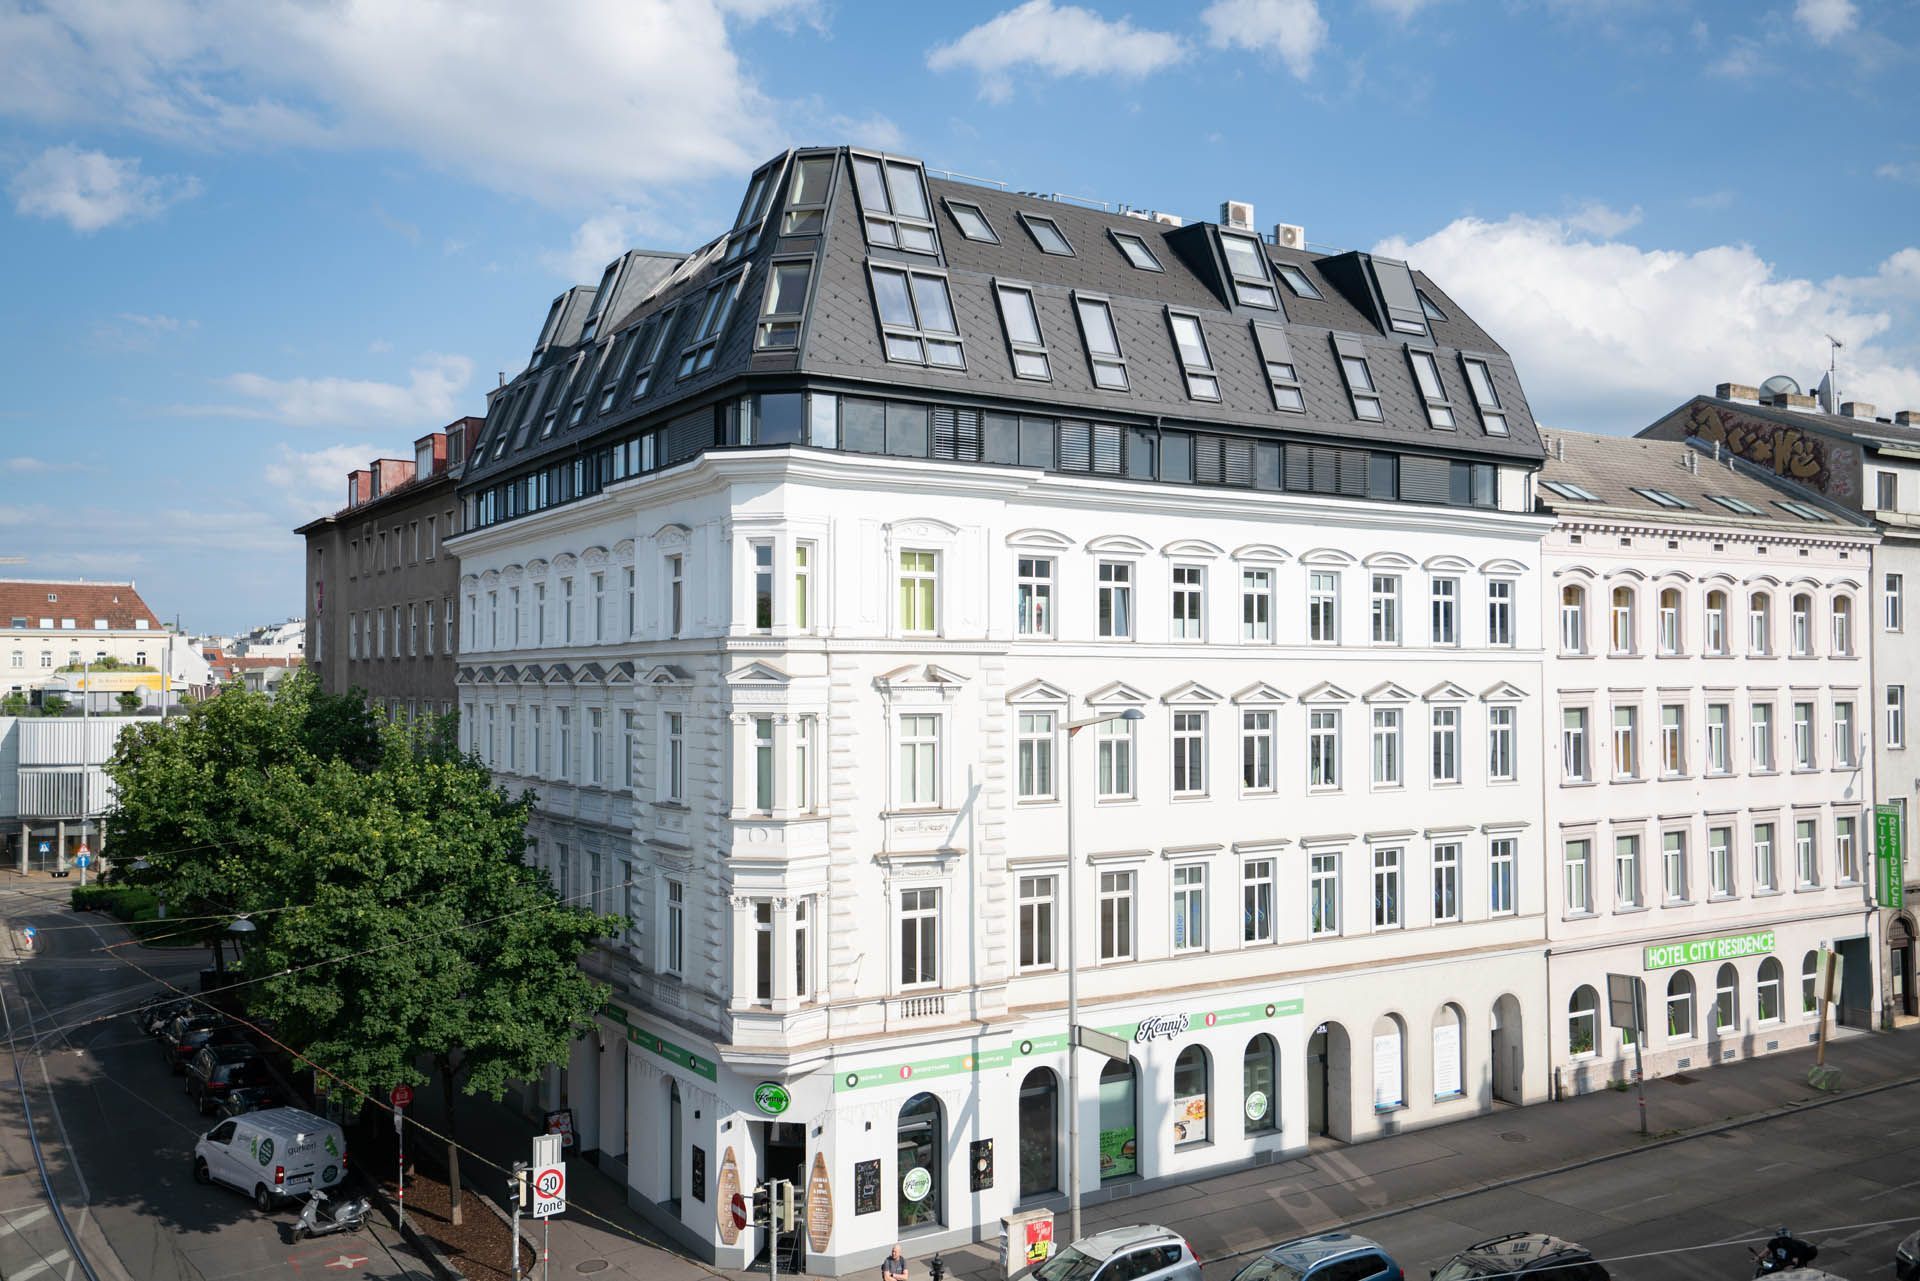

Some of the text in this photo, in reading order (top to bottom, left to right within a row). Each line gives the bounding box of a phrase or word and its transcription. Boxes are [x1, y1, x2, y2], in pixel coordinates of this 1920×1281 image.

[1878, 816, 1887, 856] CITY
[1888, 816, 1900, 906] RESIDENCE
[1648, 933, 1775, 968] HOTEL CITY RESIDENCE
[1137, 1013, 1189, 1042] Kenny's
[542, 1176, 557, 1192] 30
[536, 1200, 563, 1215] Zone
